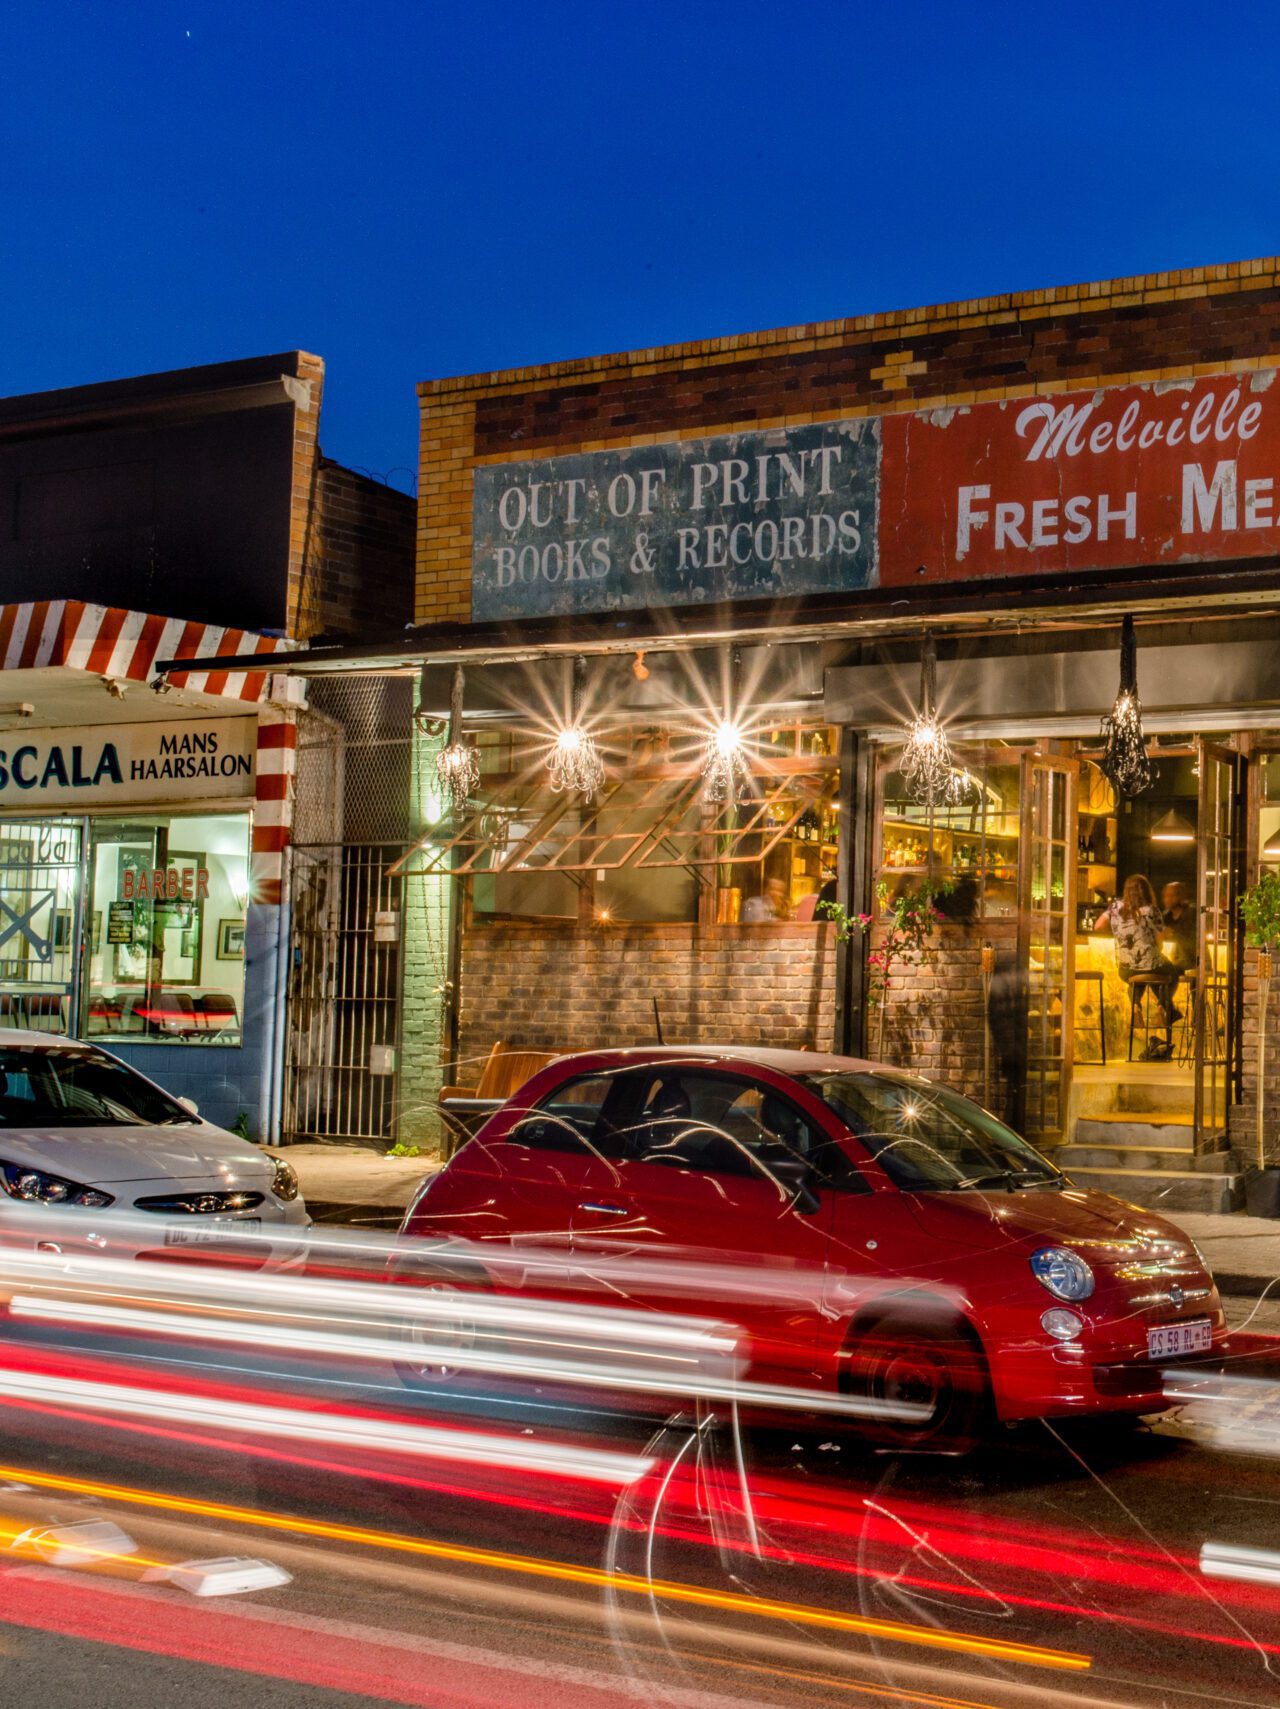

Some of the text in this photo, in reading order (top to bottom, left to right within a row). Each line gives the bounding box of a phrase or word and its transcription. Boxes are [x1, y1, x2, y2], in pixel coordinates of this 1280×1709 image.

[1015, 388, 1263, 462] Melville
[497, 445, 842, 532] OUT OF PRINT
[494, 509, 863, 588] BOOKS & RECORDS
[956, 484, 1137, 560] FRESH
[130, 754, 252, 780] HAARSALON
[159, 732, 218, 755] MANS
[122, 867, 210, 900] BARBER
[1167, 1331, 1180, 1352] 58
[1184, 1328, 1195, 1350] RL
[1202, 1325, 1211, 1347] GP
